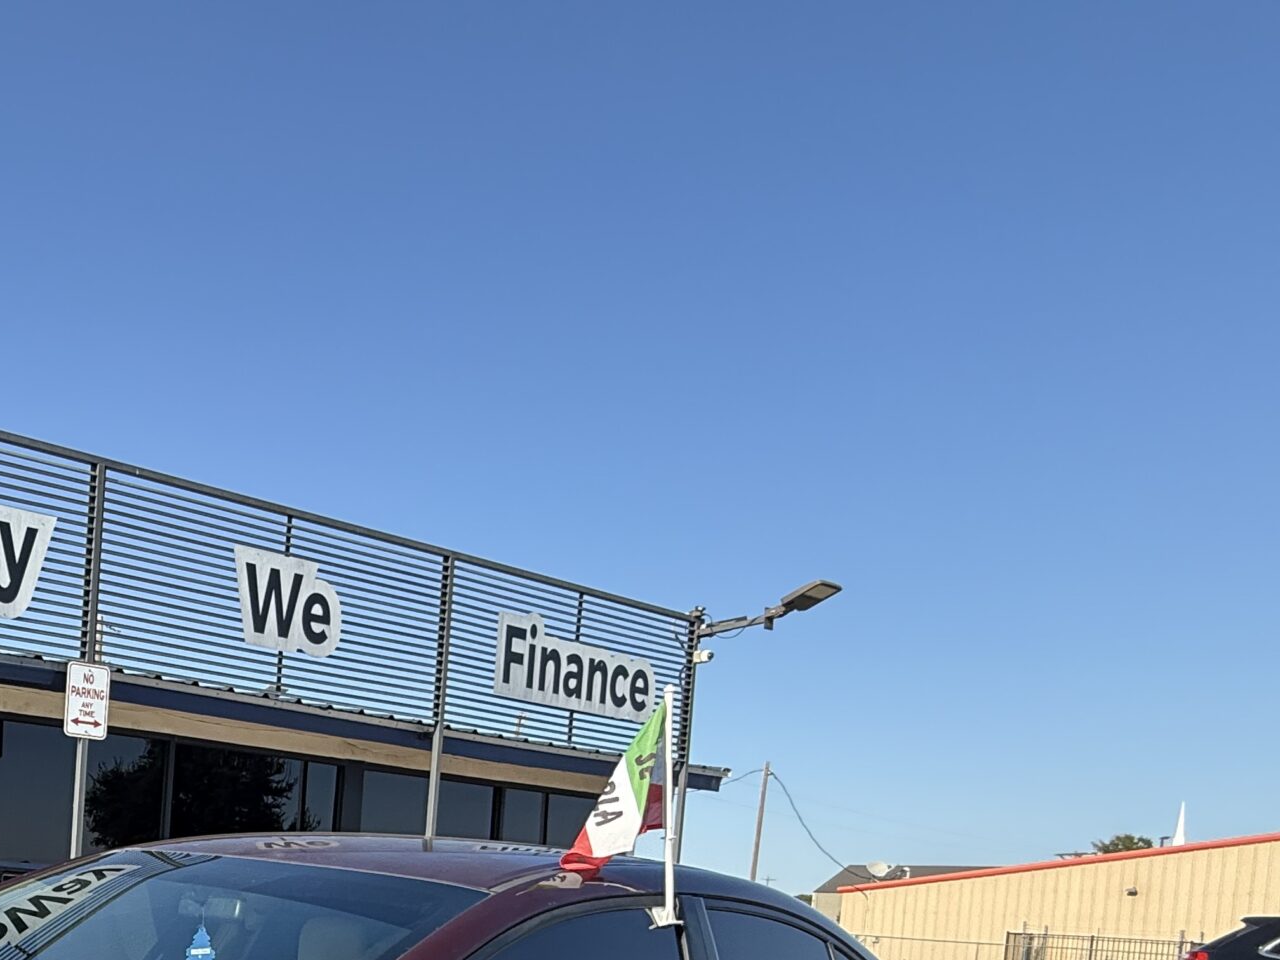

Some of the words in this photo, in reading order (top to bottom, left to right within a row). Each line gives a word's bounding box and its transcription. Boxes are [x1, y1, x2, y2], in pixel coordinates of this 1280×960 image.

[245, 561, 332, 645] We
[502, 623, 651, 712] Finance
[83, 673, 95, 684] NO
[71, 685, 104, 700] PARKING
[79, 709, 95, 718] TIME
